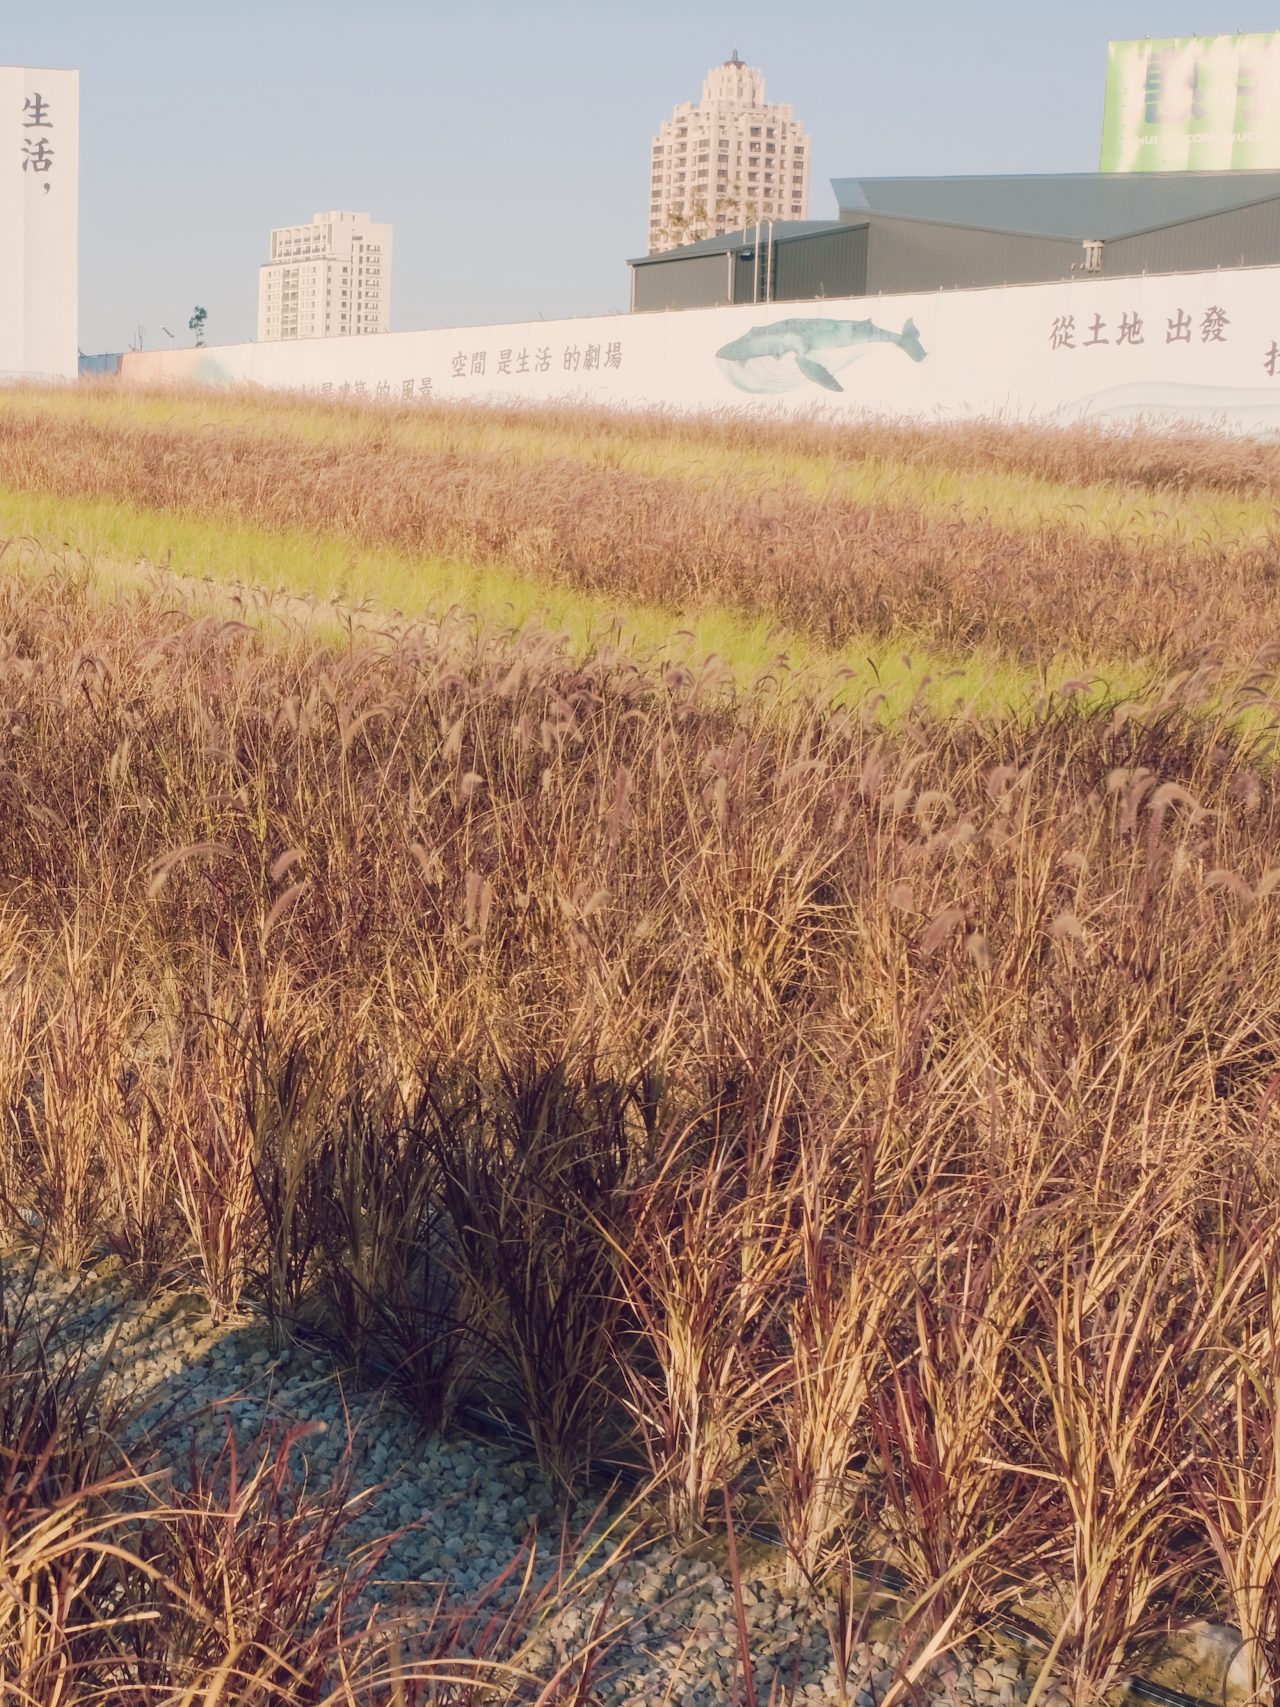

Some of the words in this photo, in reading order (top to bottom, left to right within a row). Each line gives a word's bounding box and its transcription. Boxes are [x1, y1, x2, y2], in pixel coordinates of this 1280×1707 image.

[1048, 310, 1145, 350] 從土地
[1165, 305, 1231, 344] 出發
[451, 351, 487, 378] 空間
[496, 345, 552, 375] 是生活
[563, 341, 623, 372] 的劇場
